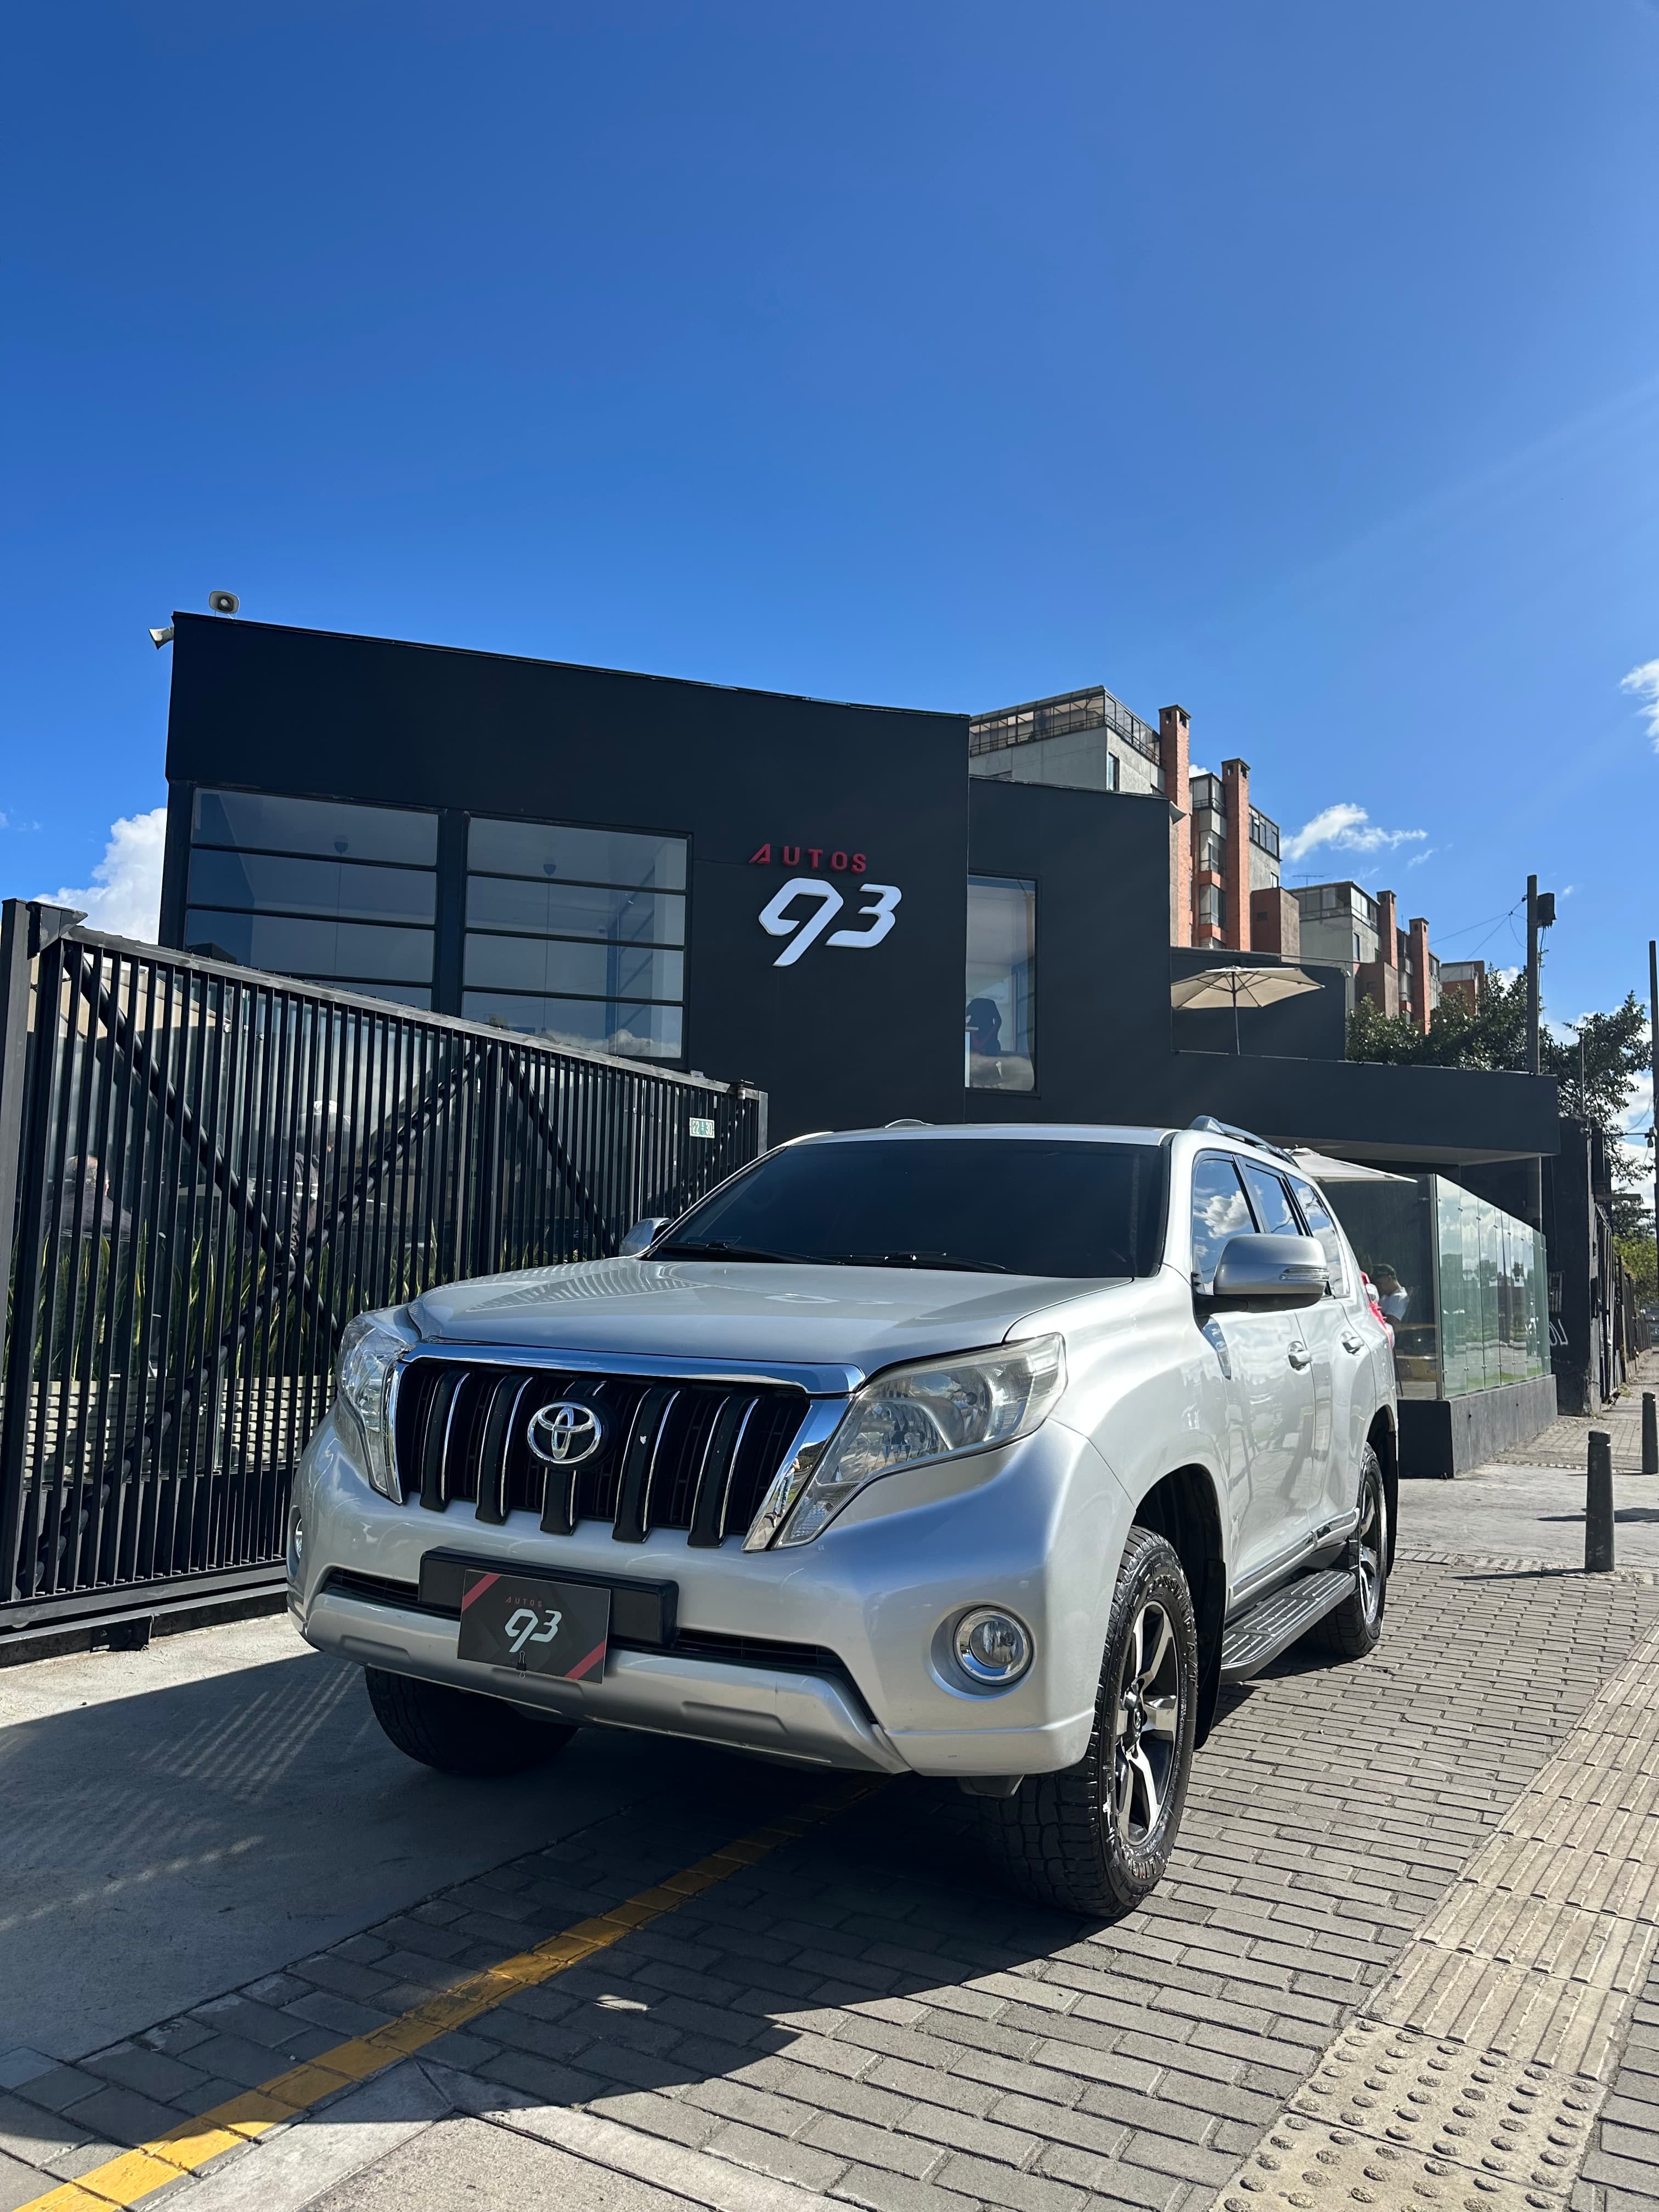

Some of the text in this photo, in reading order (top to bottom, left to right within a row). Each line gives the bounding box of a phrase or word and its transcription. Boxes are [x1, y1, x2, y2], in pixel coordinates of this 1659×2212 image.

[748, 843, 867, 873] AUTOS
[758, 877, 902, 967] 93
[692, 1120, 700, 1135] 22
[706, 1121, 713, 1136] 30
[505, 1596, 543, 1608] AUTOS
[505, 1608, 562, 1652] 93
